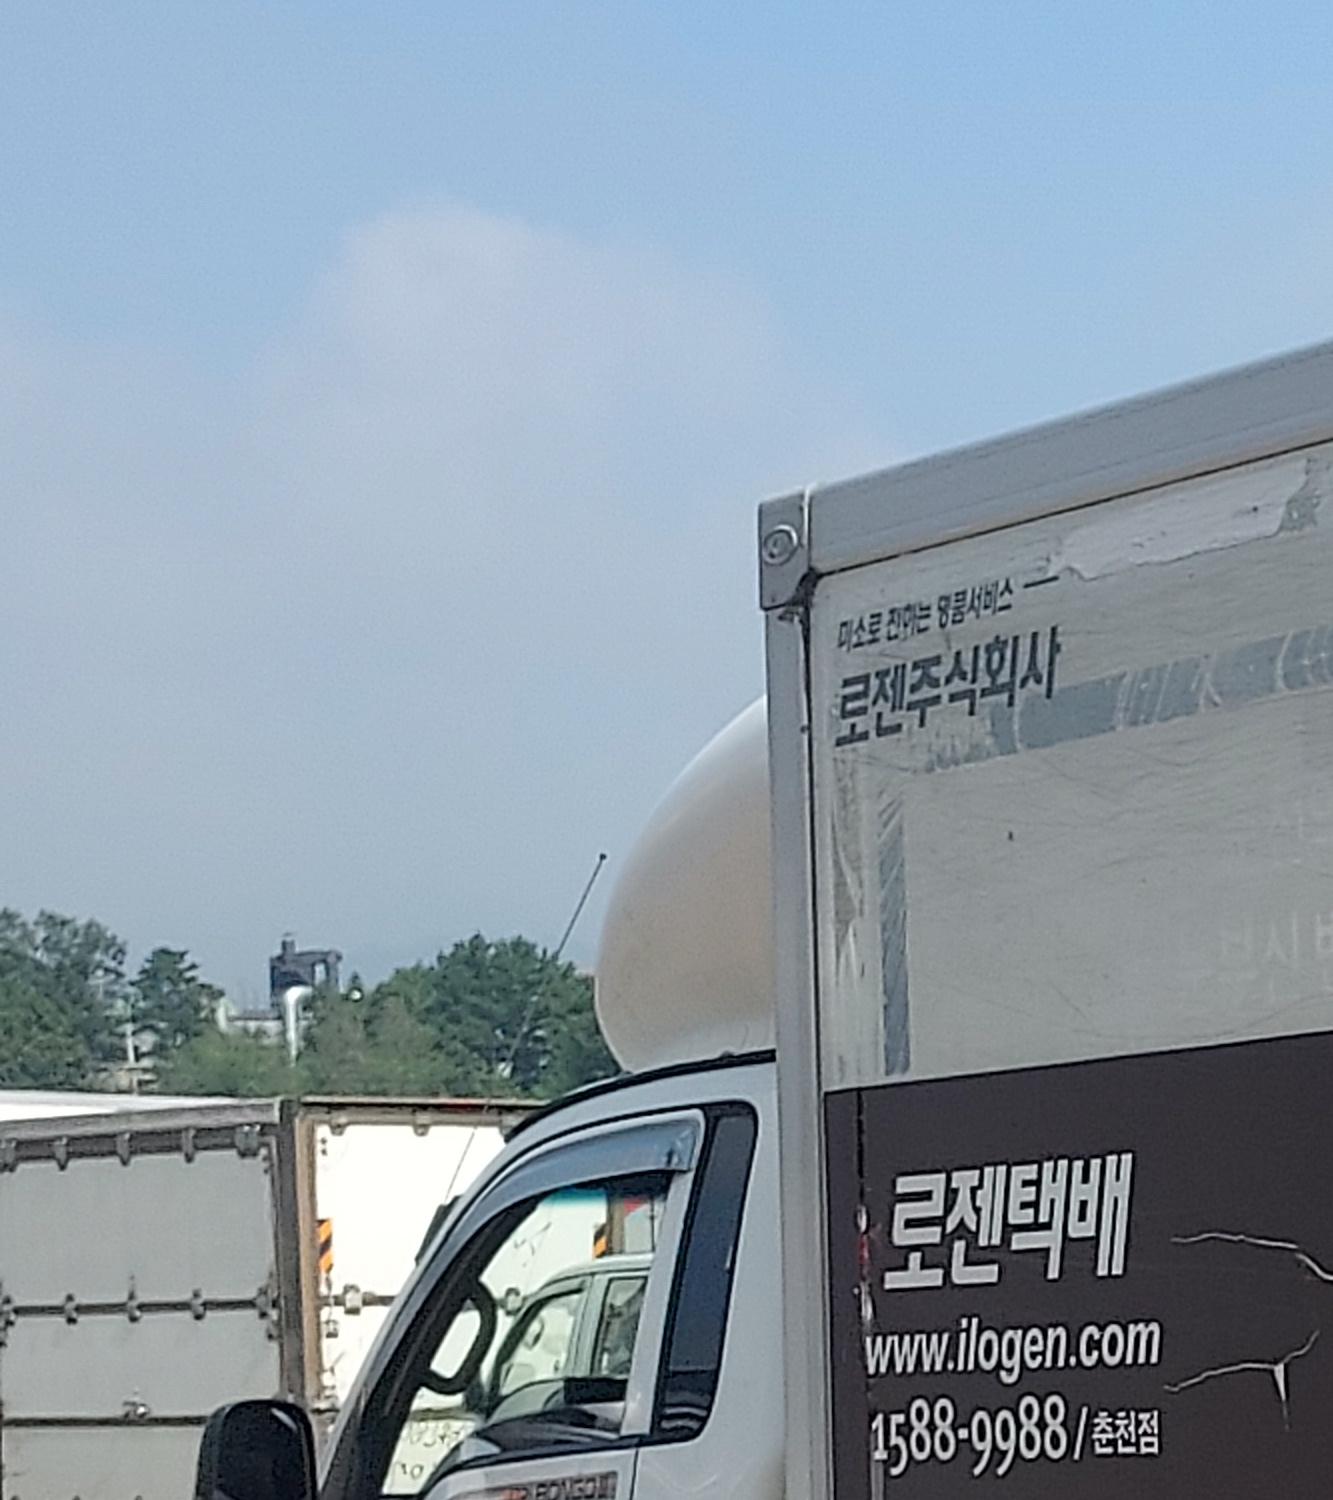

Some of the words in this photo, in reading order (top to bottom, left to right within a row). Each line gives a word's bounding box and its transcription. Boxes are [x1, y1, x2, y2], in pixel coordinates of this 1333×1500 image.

[836, 612, 882, 652] 미소로
[835, 625, 1062, 747] 로젠주식회사
[884, 1153, 1133, 1290] 로젠택배
[866, 1317, 1160, 1384] www.ilogen.com
[1091, 1410, 1160, 1456] 춘천점
